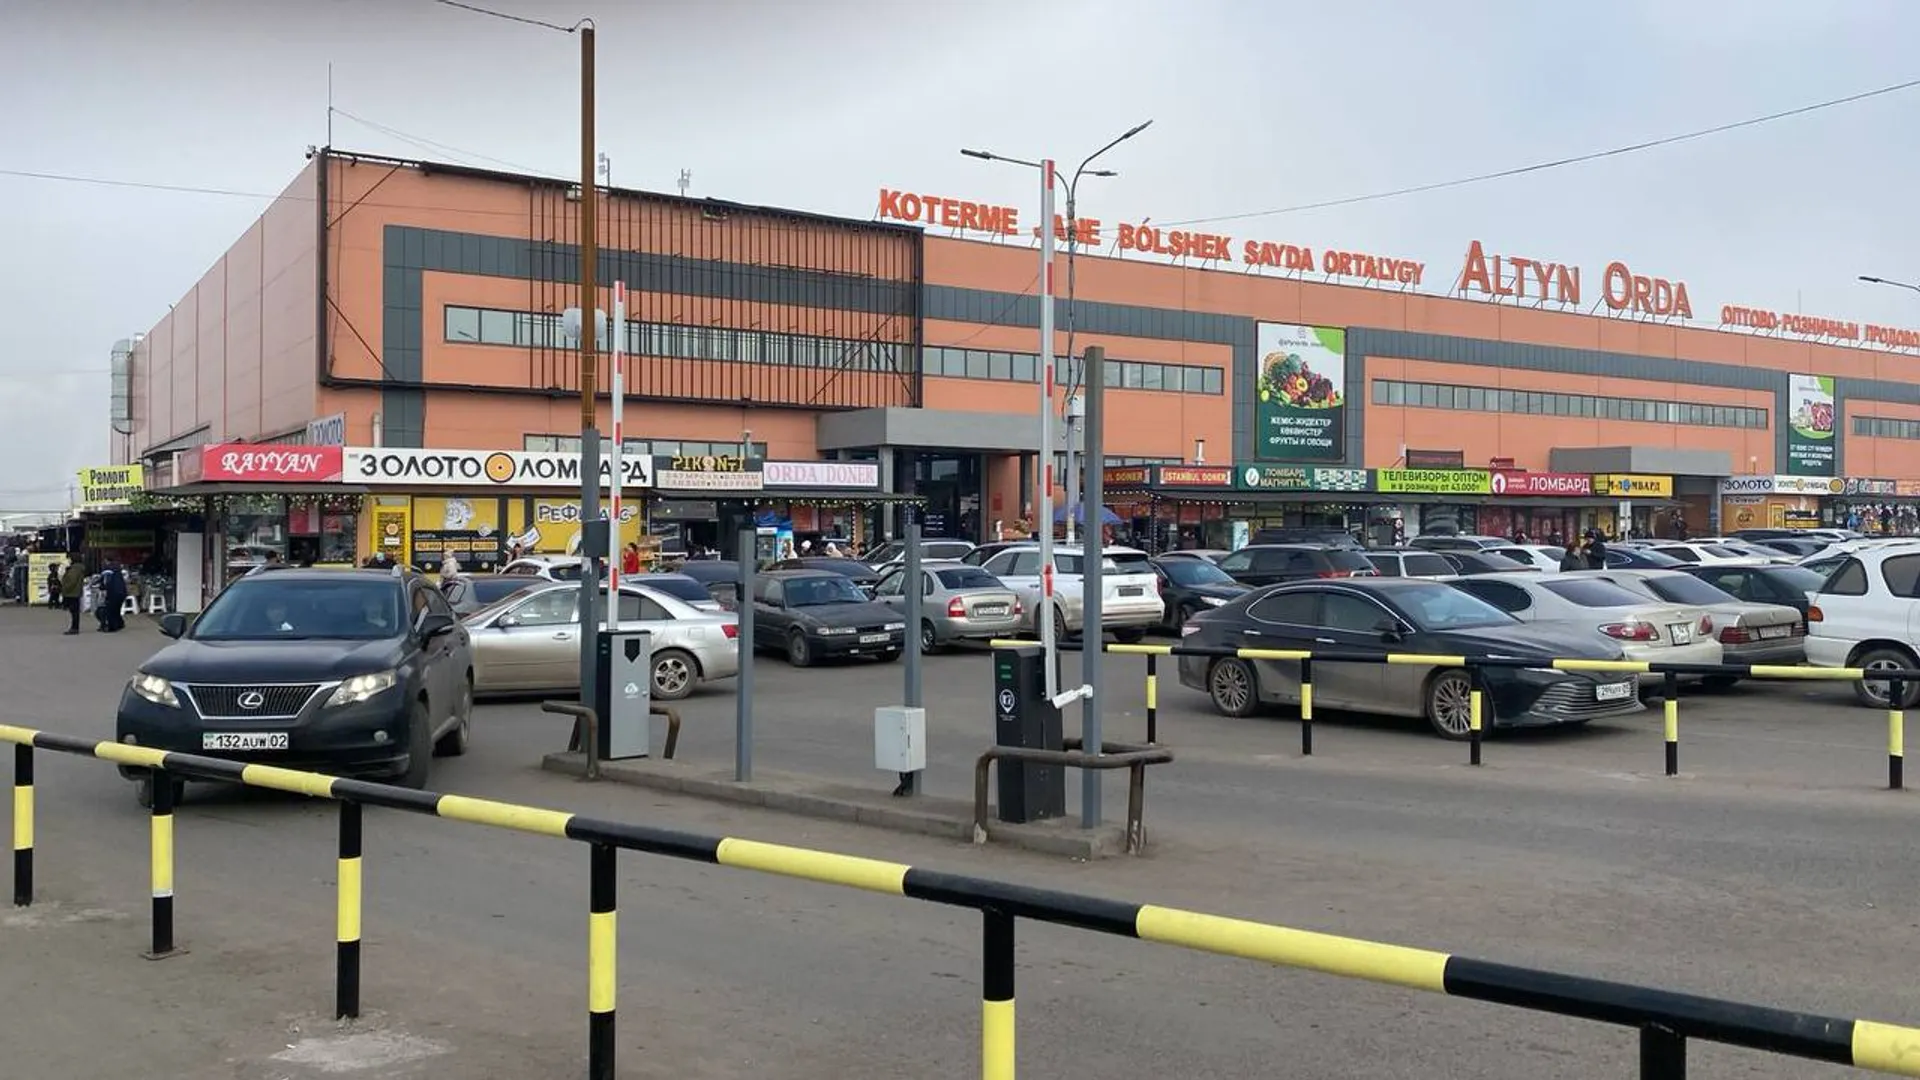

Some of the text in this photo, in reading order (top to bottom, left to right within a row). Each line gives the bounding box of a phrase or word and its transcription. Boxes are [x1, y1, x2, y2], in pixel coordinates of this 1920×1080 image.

[879, 189, 1425, 284] KOTERME ANE BÓLSHEK SAYDA ORTALYGY
[1460, 240, 1693, 319] ALTYN ORDA
[1269, 437, 1332, 448] ФРУКТЫ И ОВОЩИ
[222, 452, 322, 475] RAYYAN
[360, 453, 647, 483] ЗОЛОТО ЛОМАРД
[90, 469, 130, 484] Ремонт
[768, 464, 875, 484] ORDA DONER
[1265, 468, 1306, 479] ЛОМБАРД
[1383, 471, 1487, 483] ТЕЛЕВИЗОРЫ ОПТОМ
[1406, 484, 1438, 493] розницу
[1529, 476, 1590, 494] ЛОМБАРД
[1724, 478, 1773, 491] ЗОЛОТО
[216, 734, 240, 747] 132
[242, 737, 267, 747] AUW
[270, 735, 287, 747] 02
